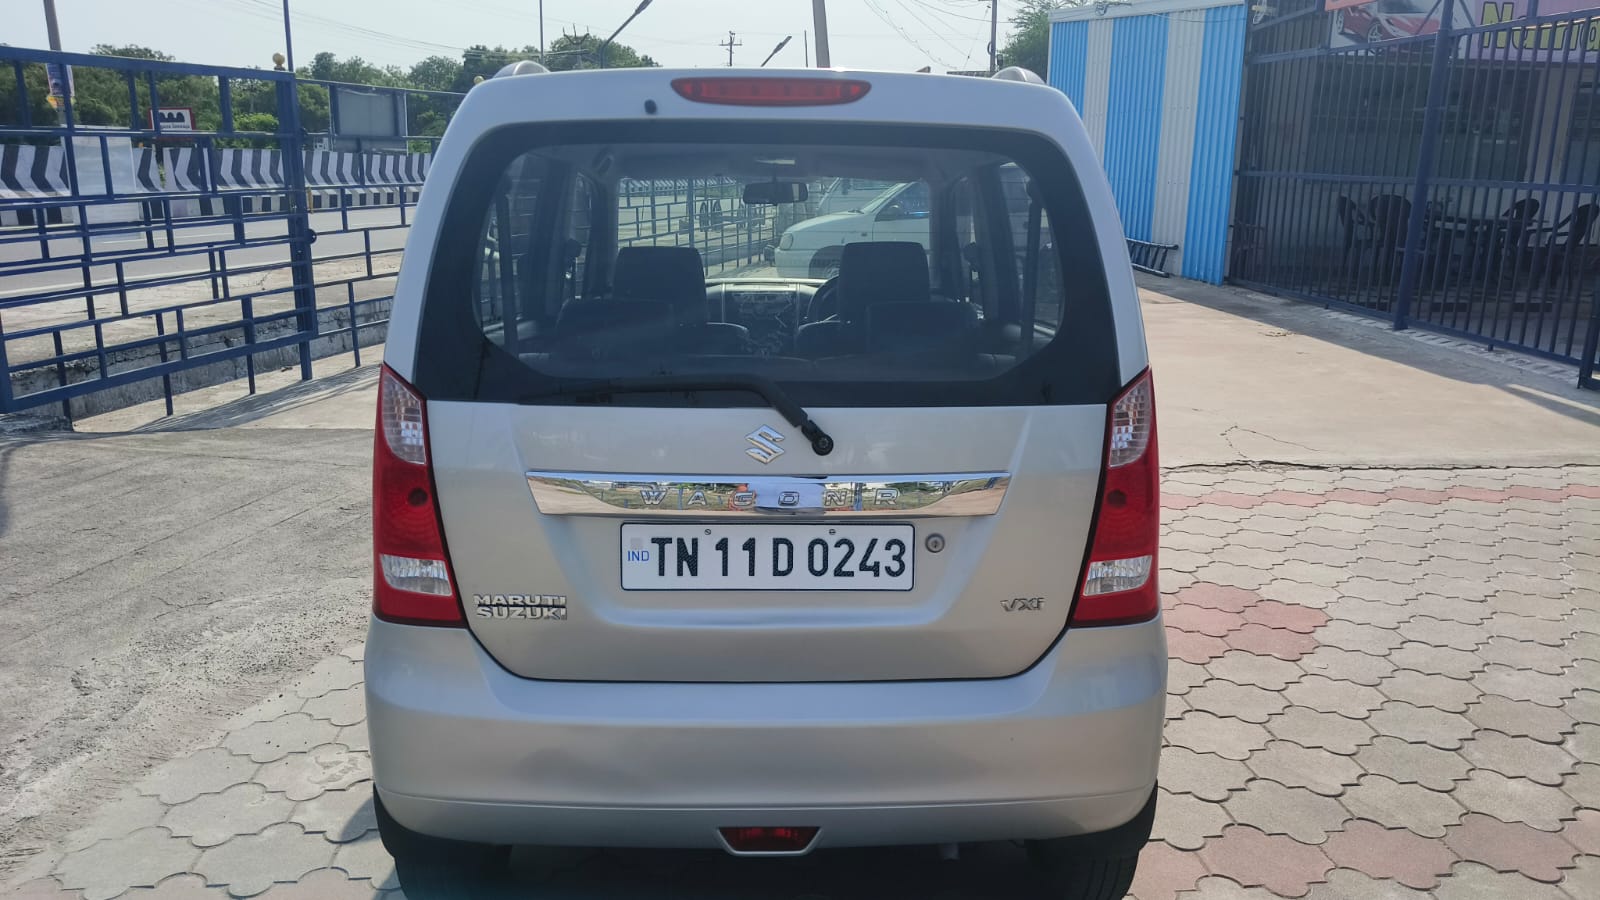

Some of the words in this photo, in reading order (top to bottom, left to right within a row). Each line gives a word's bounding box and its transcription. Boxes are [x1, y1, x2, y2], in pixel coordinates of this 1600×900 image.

[627, 550, 650, 562] IND
[651, 537, 699, 577] TN
[715, 537, 756, 577] 11
[772, 537, 794, 577] D
[807, 538, 907, 578] 0243
[473, 594, 567, 606] MARUTI
[476, 605, 568, 621] SUZUKI
